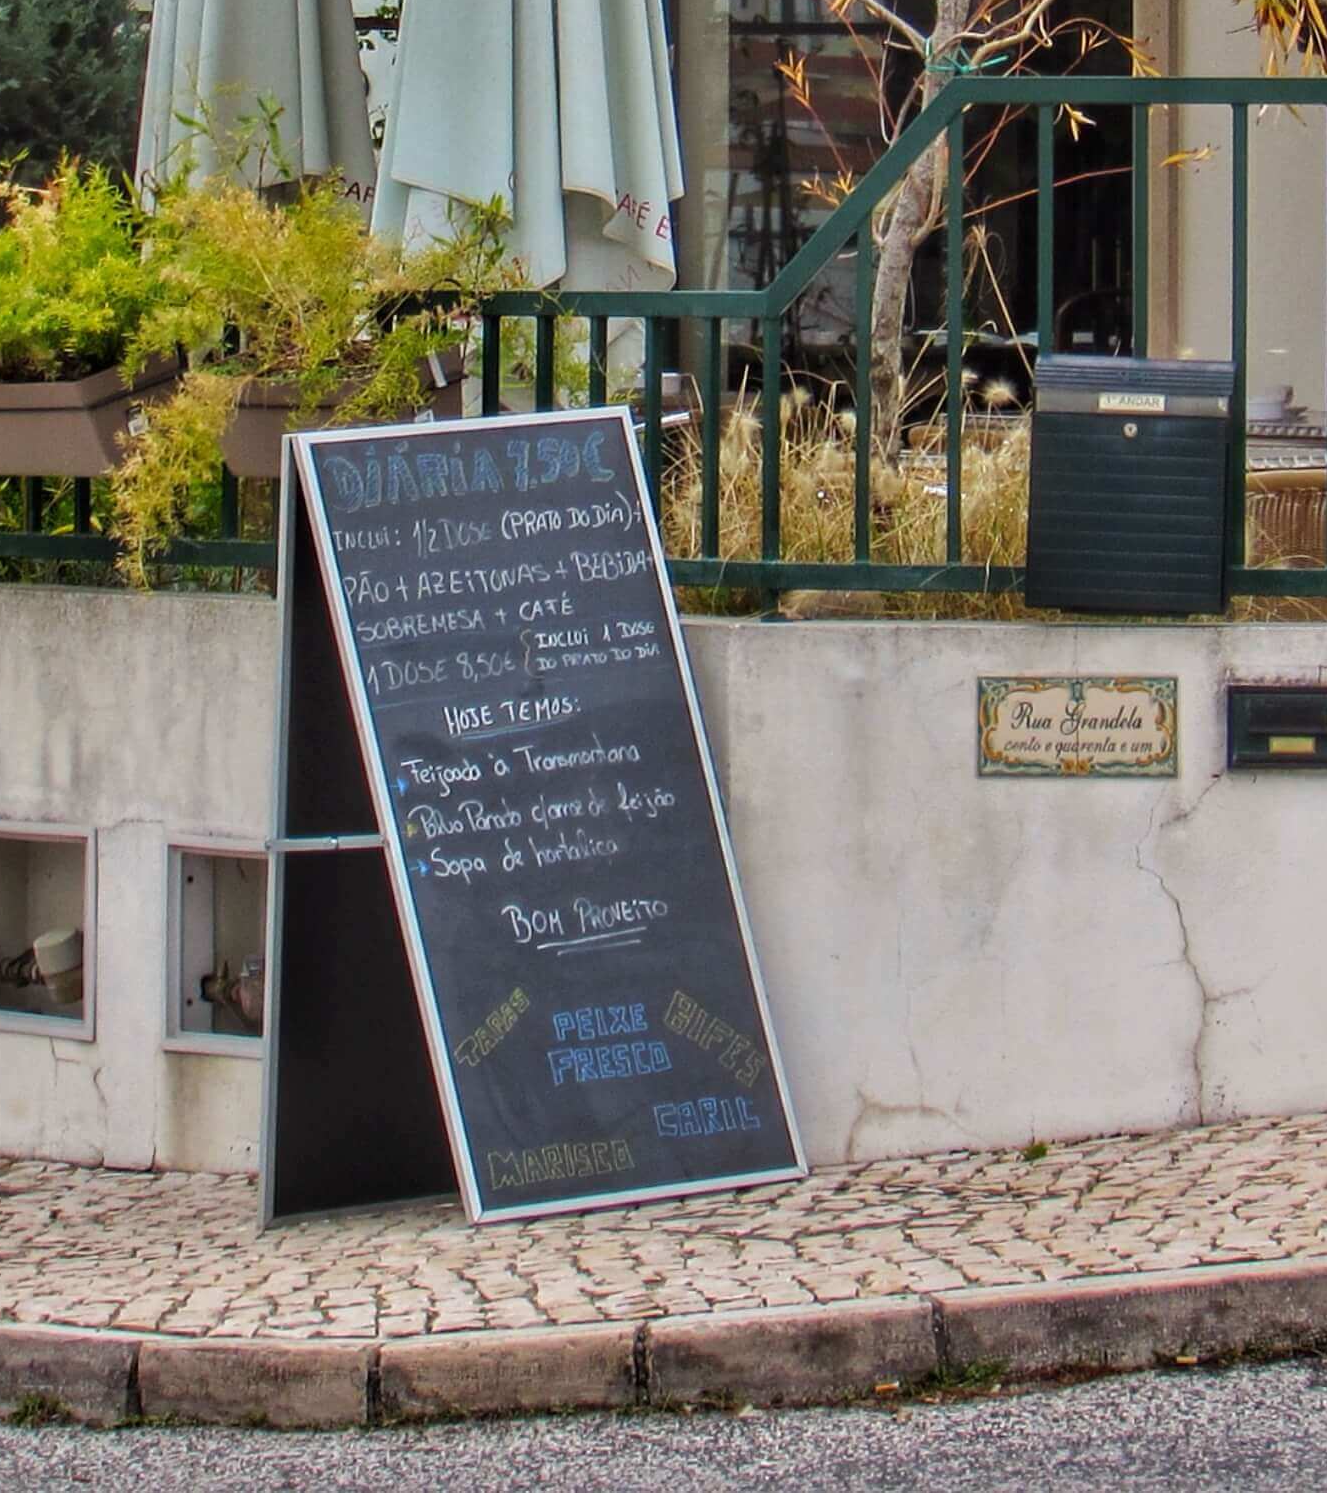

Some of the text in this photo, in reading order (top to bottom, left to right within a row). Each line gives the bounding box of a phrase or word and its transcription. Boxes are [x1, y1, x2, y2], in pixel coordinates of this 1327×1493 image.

[1119, 395, 1161, 408] ANDAR
[437, 517, 493, 550] DOSE
[343, 570, 390, 608] PÃO
[356, 609, 486, 643] SOBREMESA
[367, 665, 380, 696] 1
[381, 658, 449, 691] DOSE
[443, 696, 582, 738] HOJE TEMOS:
[1011, 701, 1143, 736] Rua Grandela
[1004, 736, 1041, 752] cento
[1055, 737, 1116, 758] quarenta
[1130, 742, 1153, 753] um
[430, 847, 487, 885] Sopa
[502, 837, 524, 872] de
[501, 905, 565, 944] BOM
[553, 1003, 649, 1041] PEIXE
[663, 989, 766, 1089] BIFES
[546, 1041, 673, 1086] FRESCO
[653, 1095, 761, 1137] CARIL
[487, 1139, 635, 1190] MARISCO
